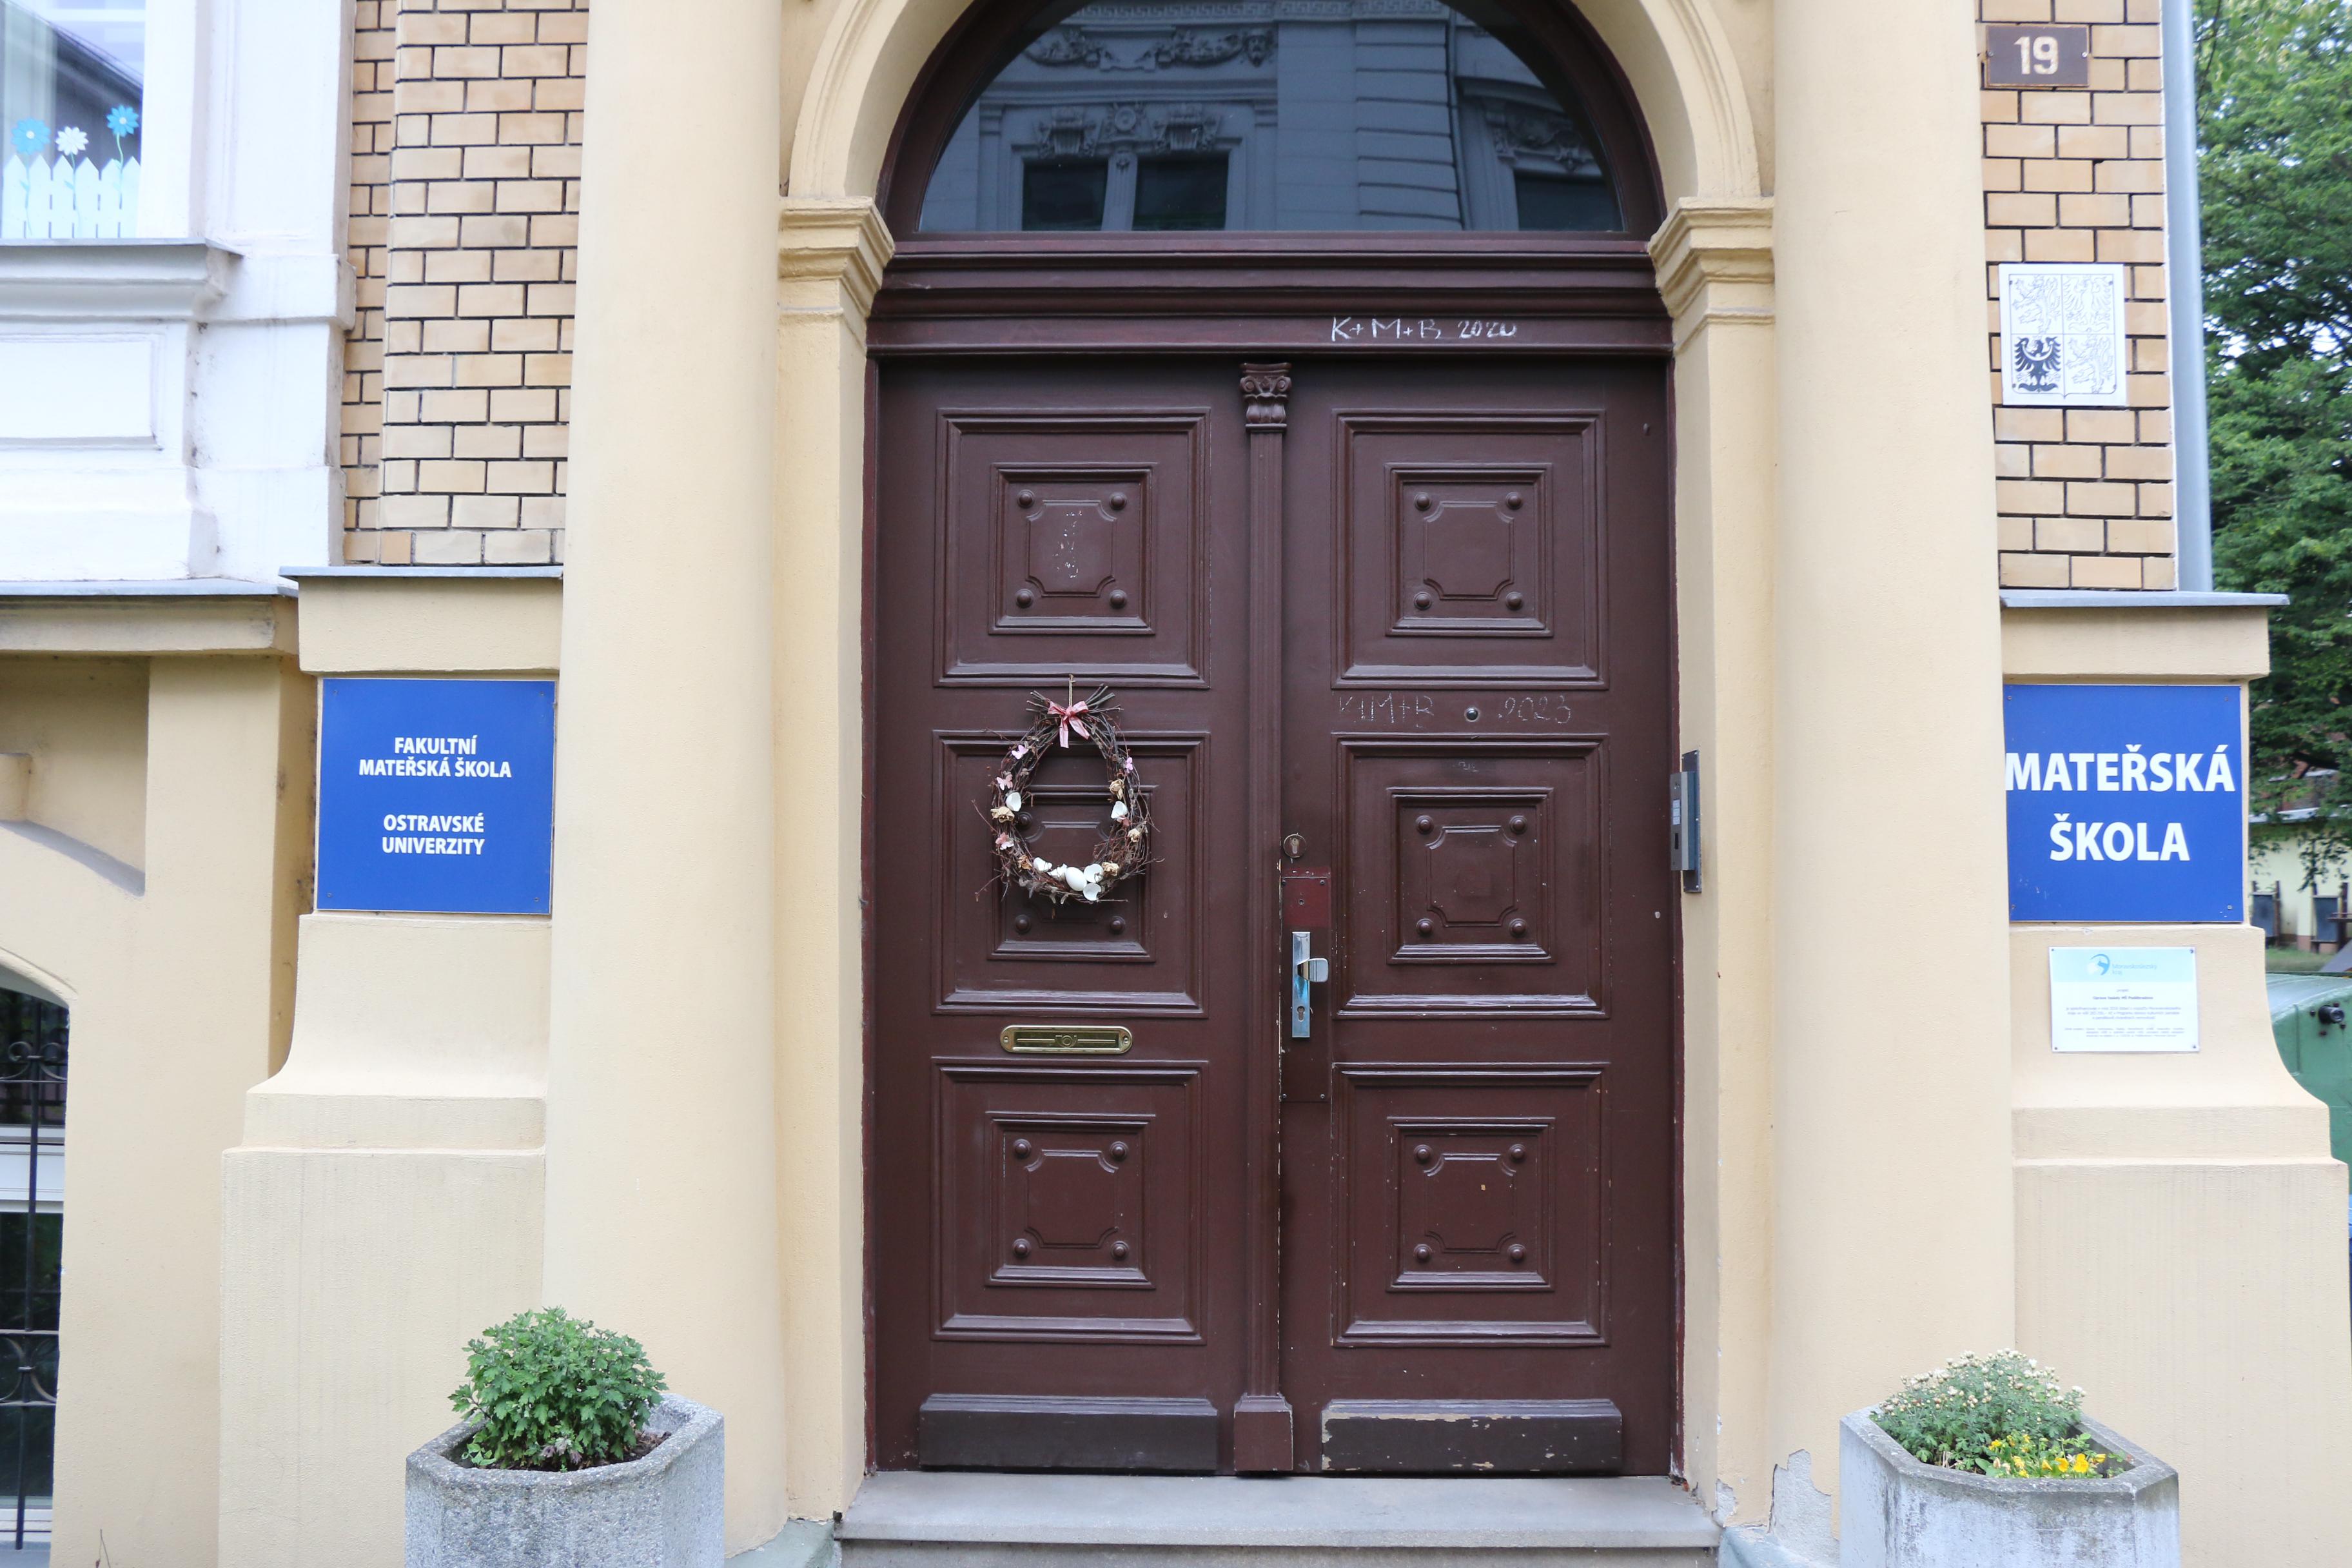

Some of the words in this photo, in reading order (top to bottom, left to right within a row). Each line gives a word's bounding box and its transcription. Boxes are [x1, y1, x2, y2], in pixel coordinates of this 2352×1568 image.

[2014, 36, 2058, 74] 19
[395, 734, 478, 754] FAKULTNÍ
[358, 756, 451, 777] MATEŘSKÁ
[455, 757, 512, 778] ŠKOLA
[2005, 744, 2236, 792] MATEŘSKÁ
[383, 812, 484, 833] OSTRAVSKÉ
[382, 837, 485, 855] UNIVERZITY
[2049, 813, 2190, 861] ŠKOLA
